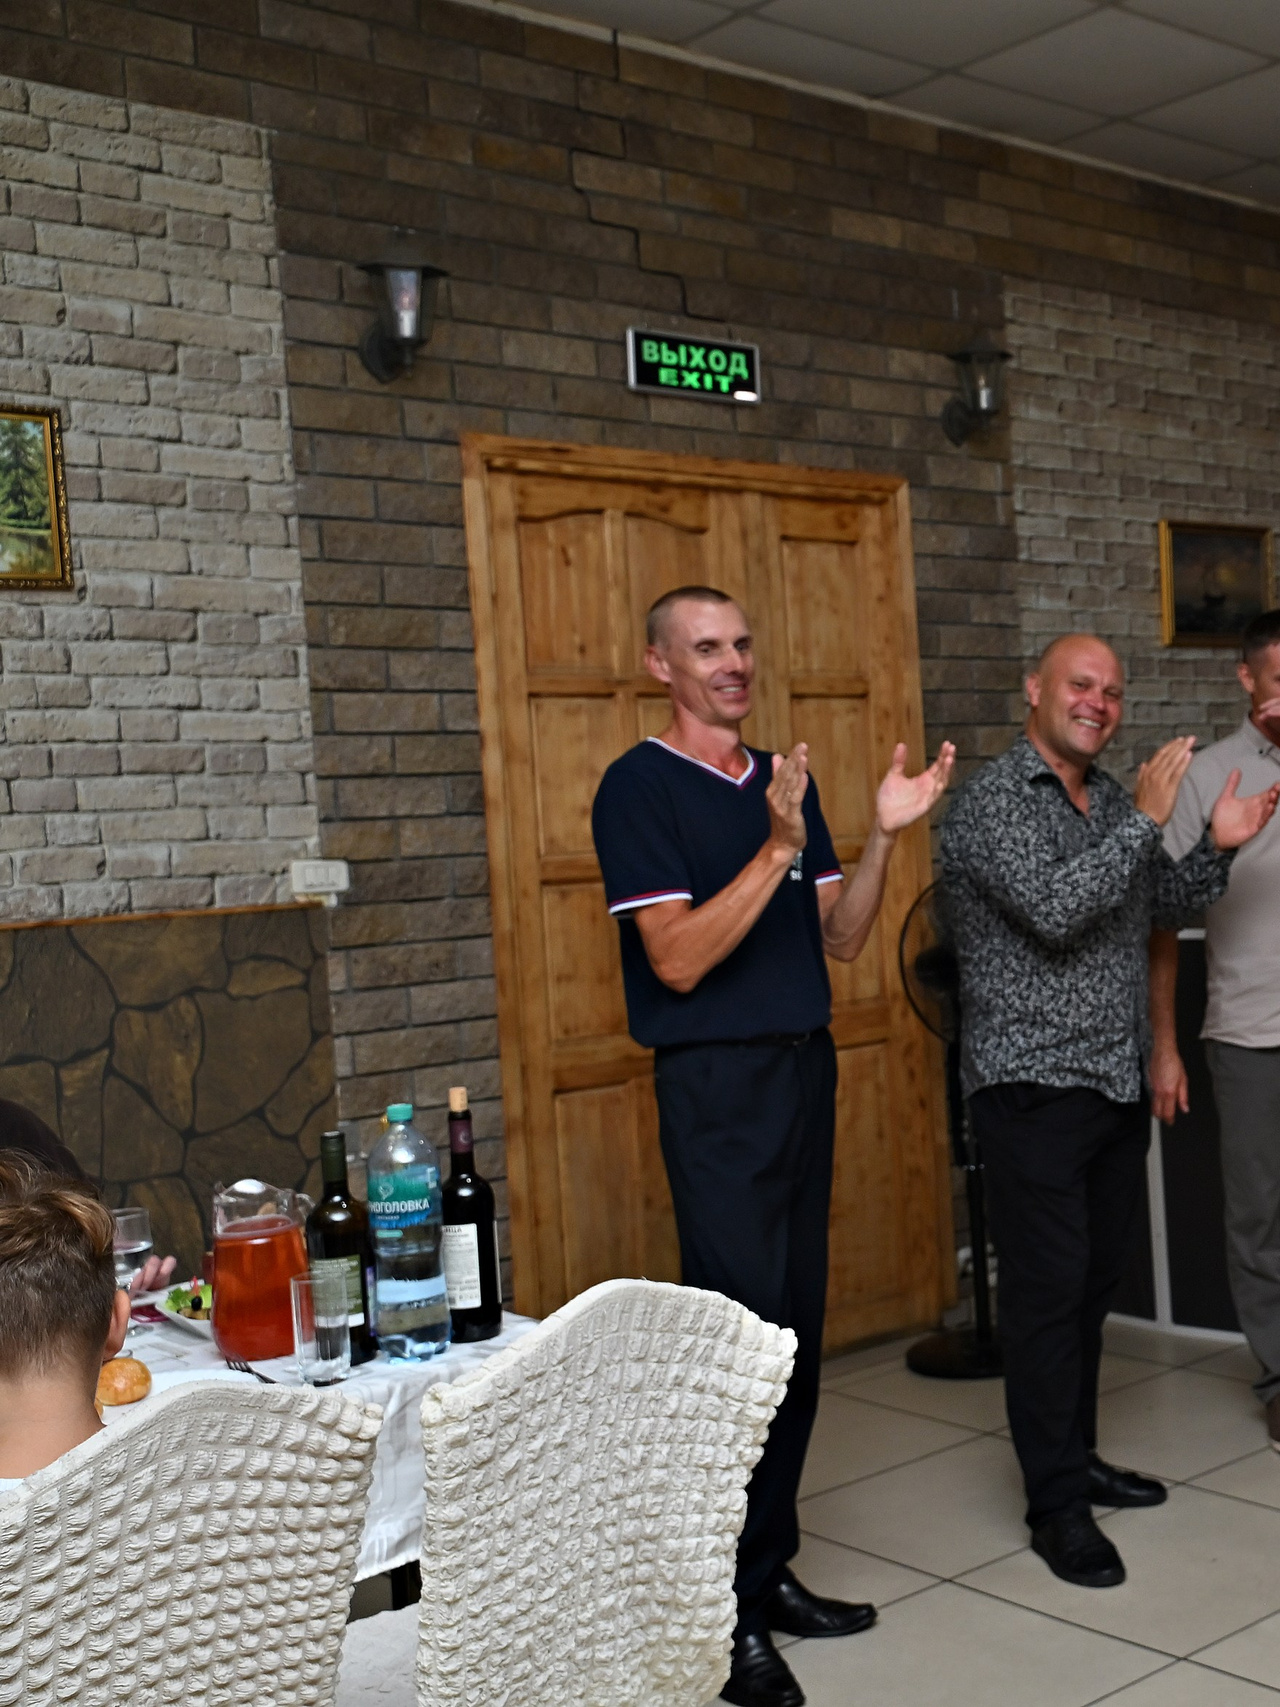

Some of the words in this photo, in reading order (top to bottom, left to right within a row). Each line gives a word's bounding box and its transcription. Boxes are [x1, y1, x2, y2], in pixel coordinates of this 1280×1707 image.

[641, 339, 749, 380] ВЫХОД
[658, 367, 734, 393] EXIT
[368, 1198, 430, 1214] НОГОЛОВКА
